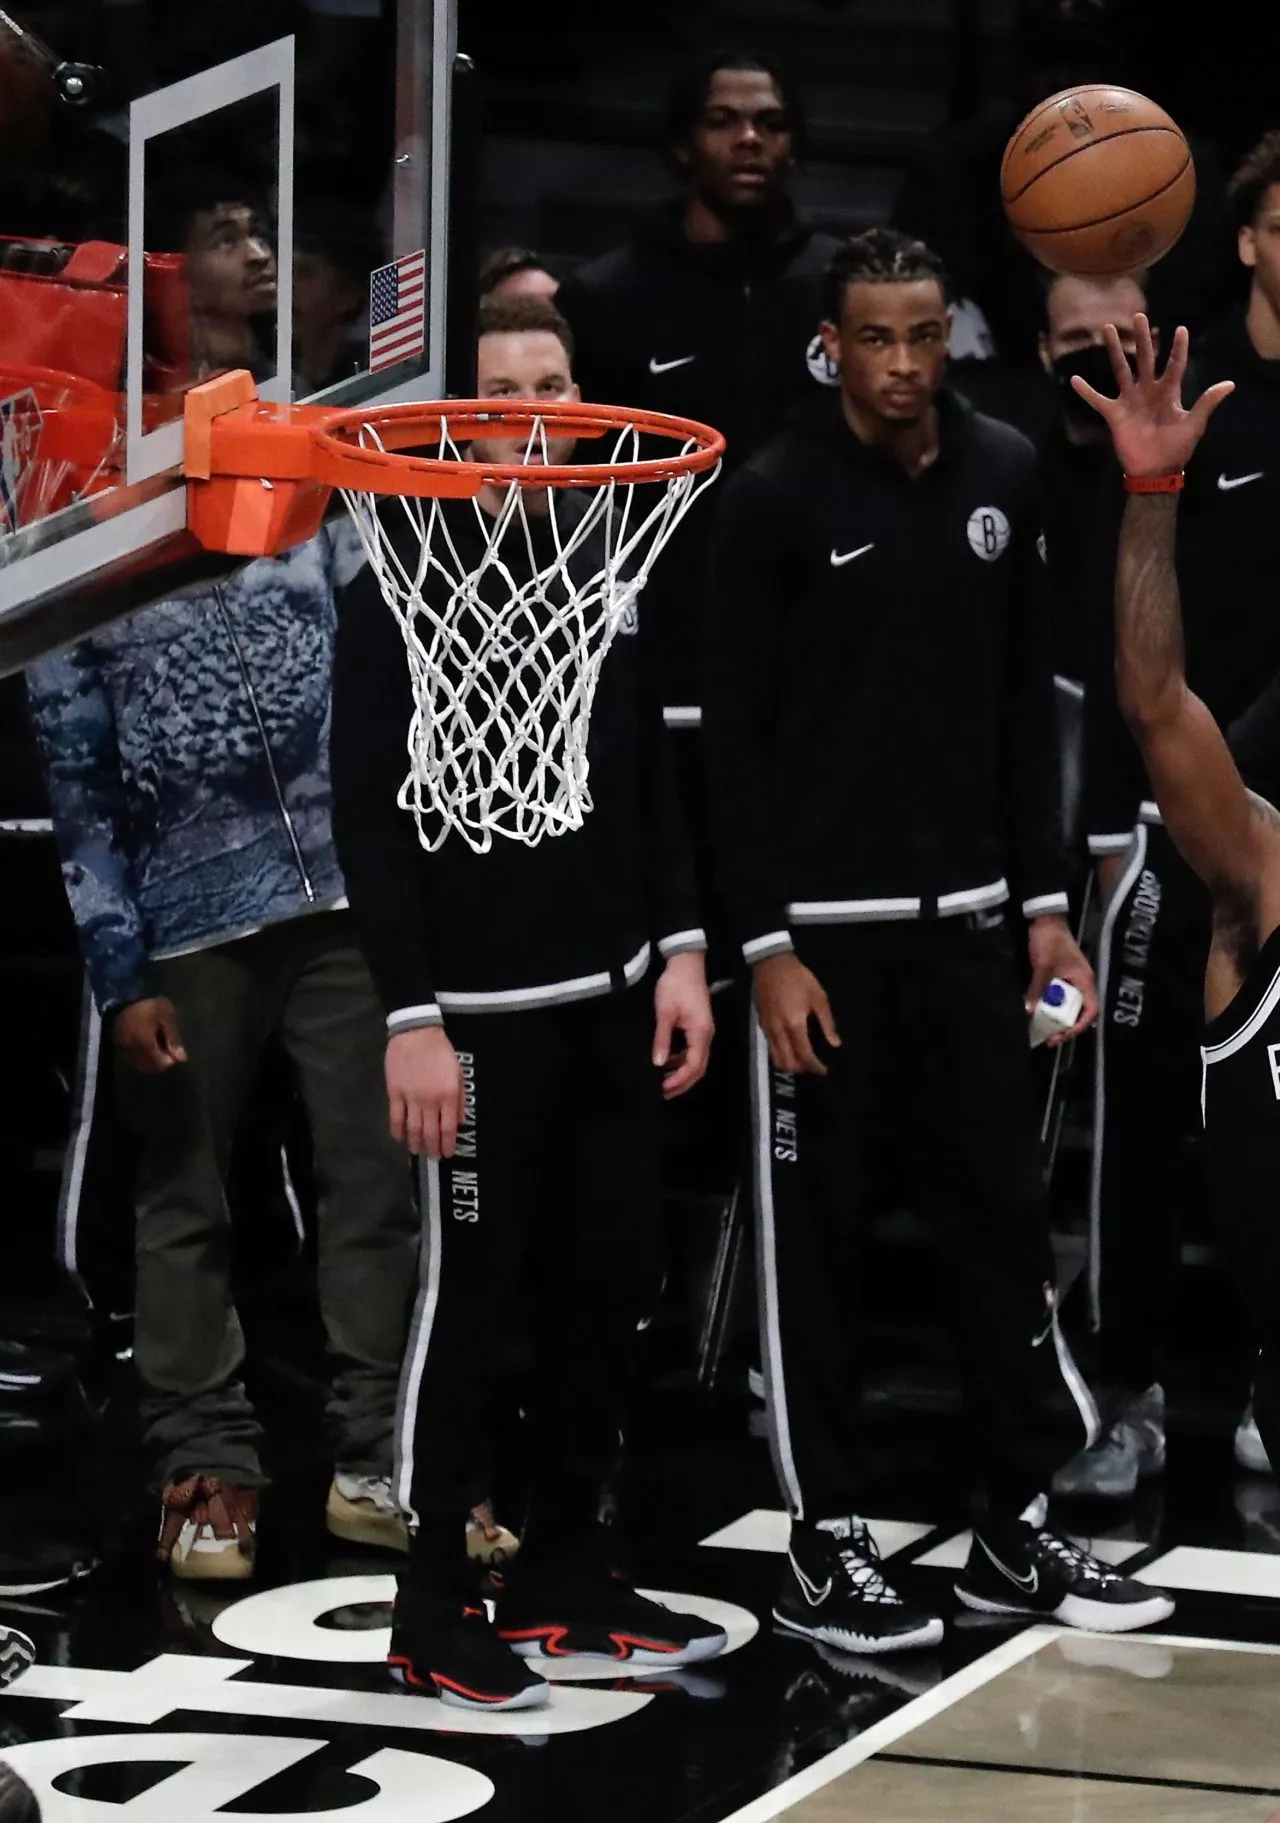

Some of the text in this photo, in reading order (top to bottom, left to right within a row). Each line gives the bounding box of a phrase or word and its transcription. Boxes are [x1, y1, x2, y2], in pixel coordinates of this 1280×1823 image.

[1113, 974, 1145, 1027] NETS
[774, 1108, 798, 1162] NETS
[451, 1169, 479, 1223] NETS
